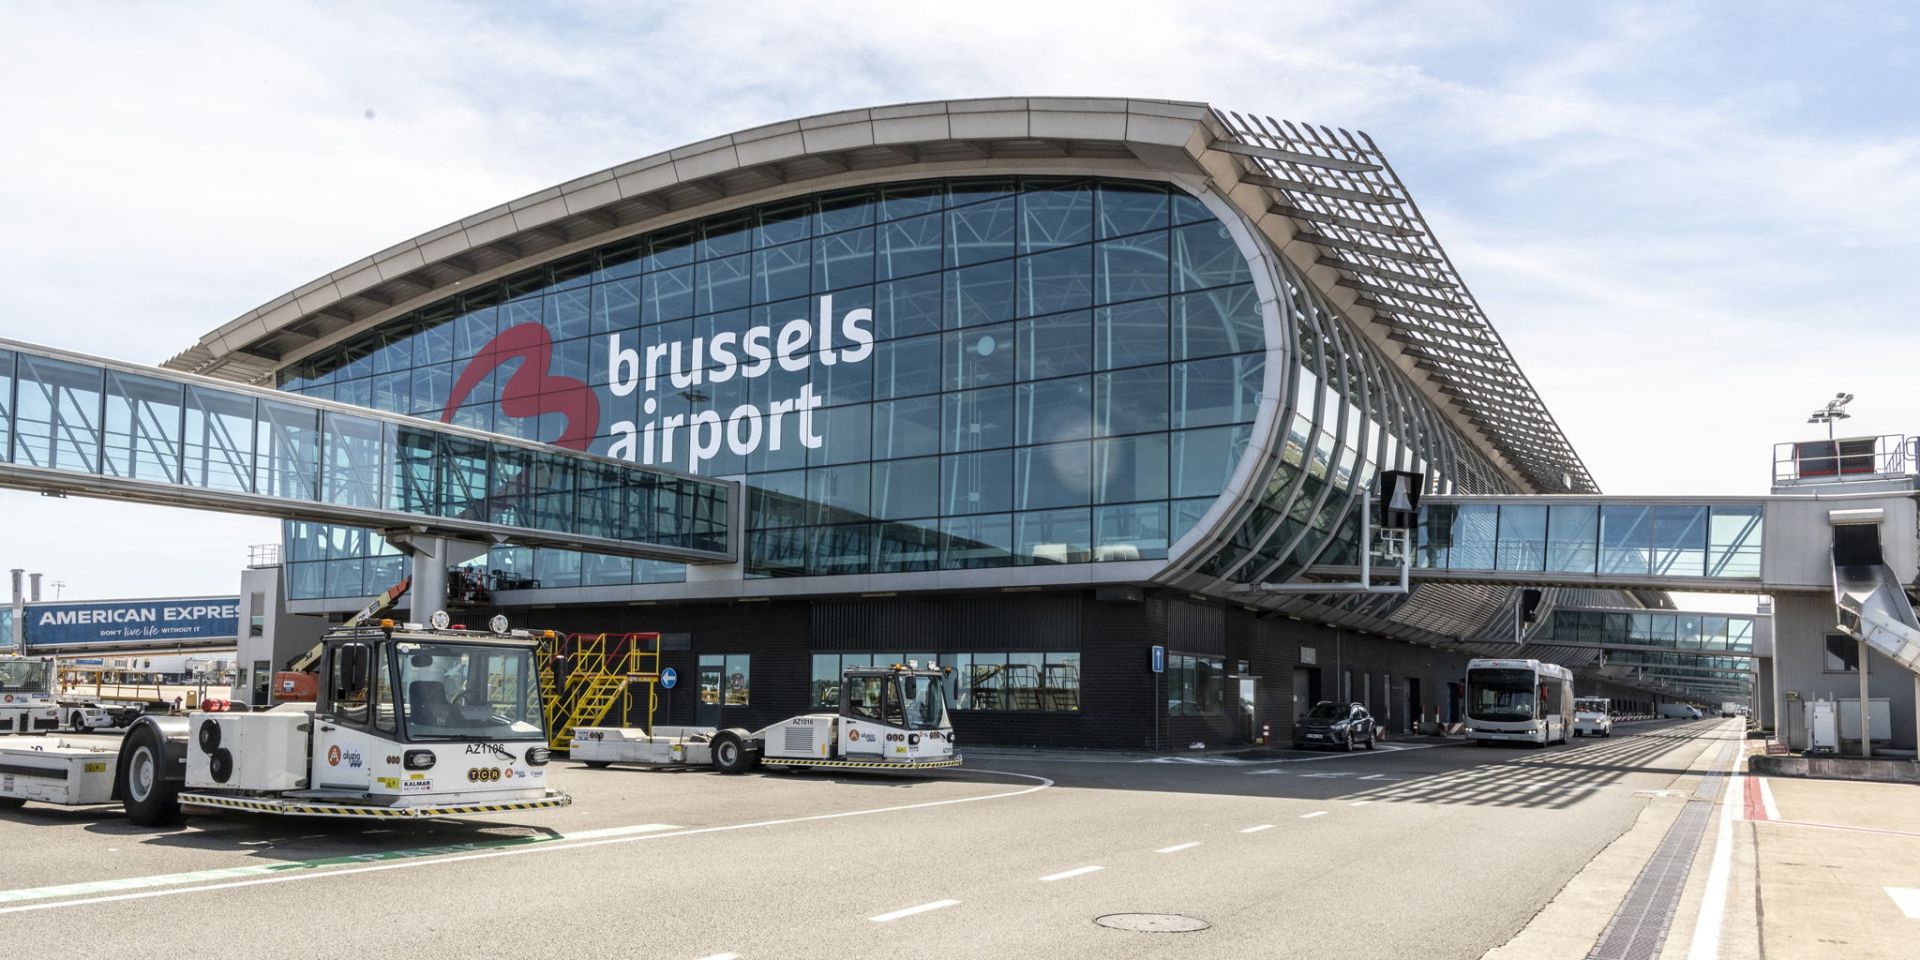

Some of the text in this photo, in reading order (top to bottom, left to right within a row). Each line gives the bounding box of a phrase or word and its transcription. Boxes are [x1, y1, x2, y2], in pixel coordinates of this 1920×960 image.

[608, 294, 873, 397] brussels
[607, 382, 822, 474] airport
[38, 608, 157, 626] AMERICAN
[123, 626, 142, 637] live
[143, 625, 159, 637] life
[469, 768, 499, 781] TCR
